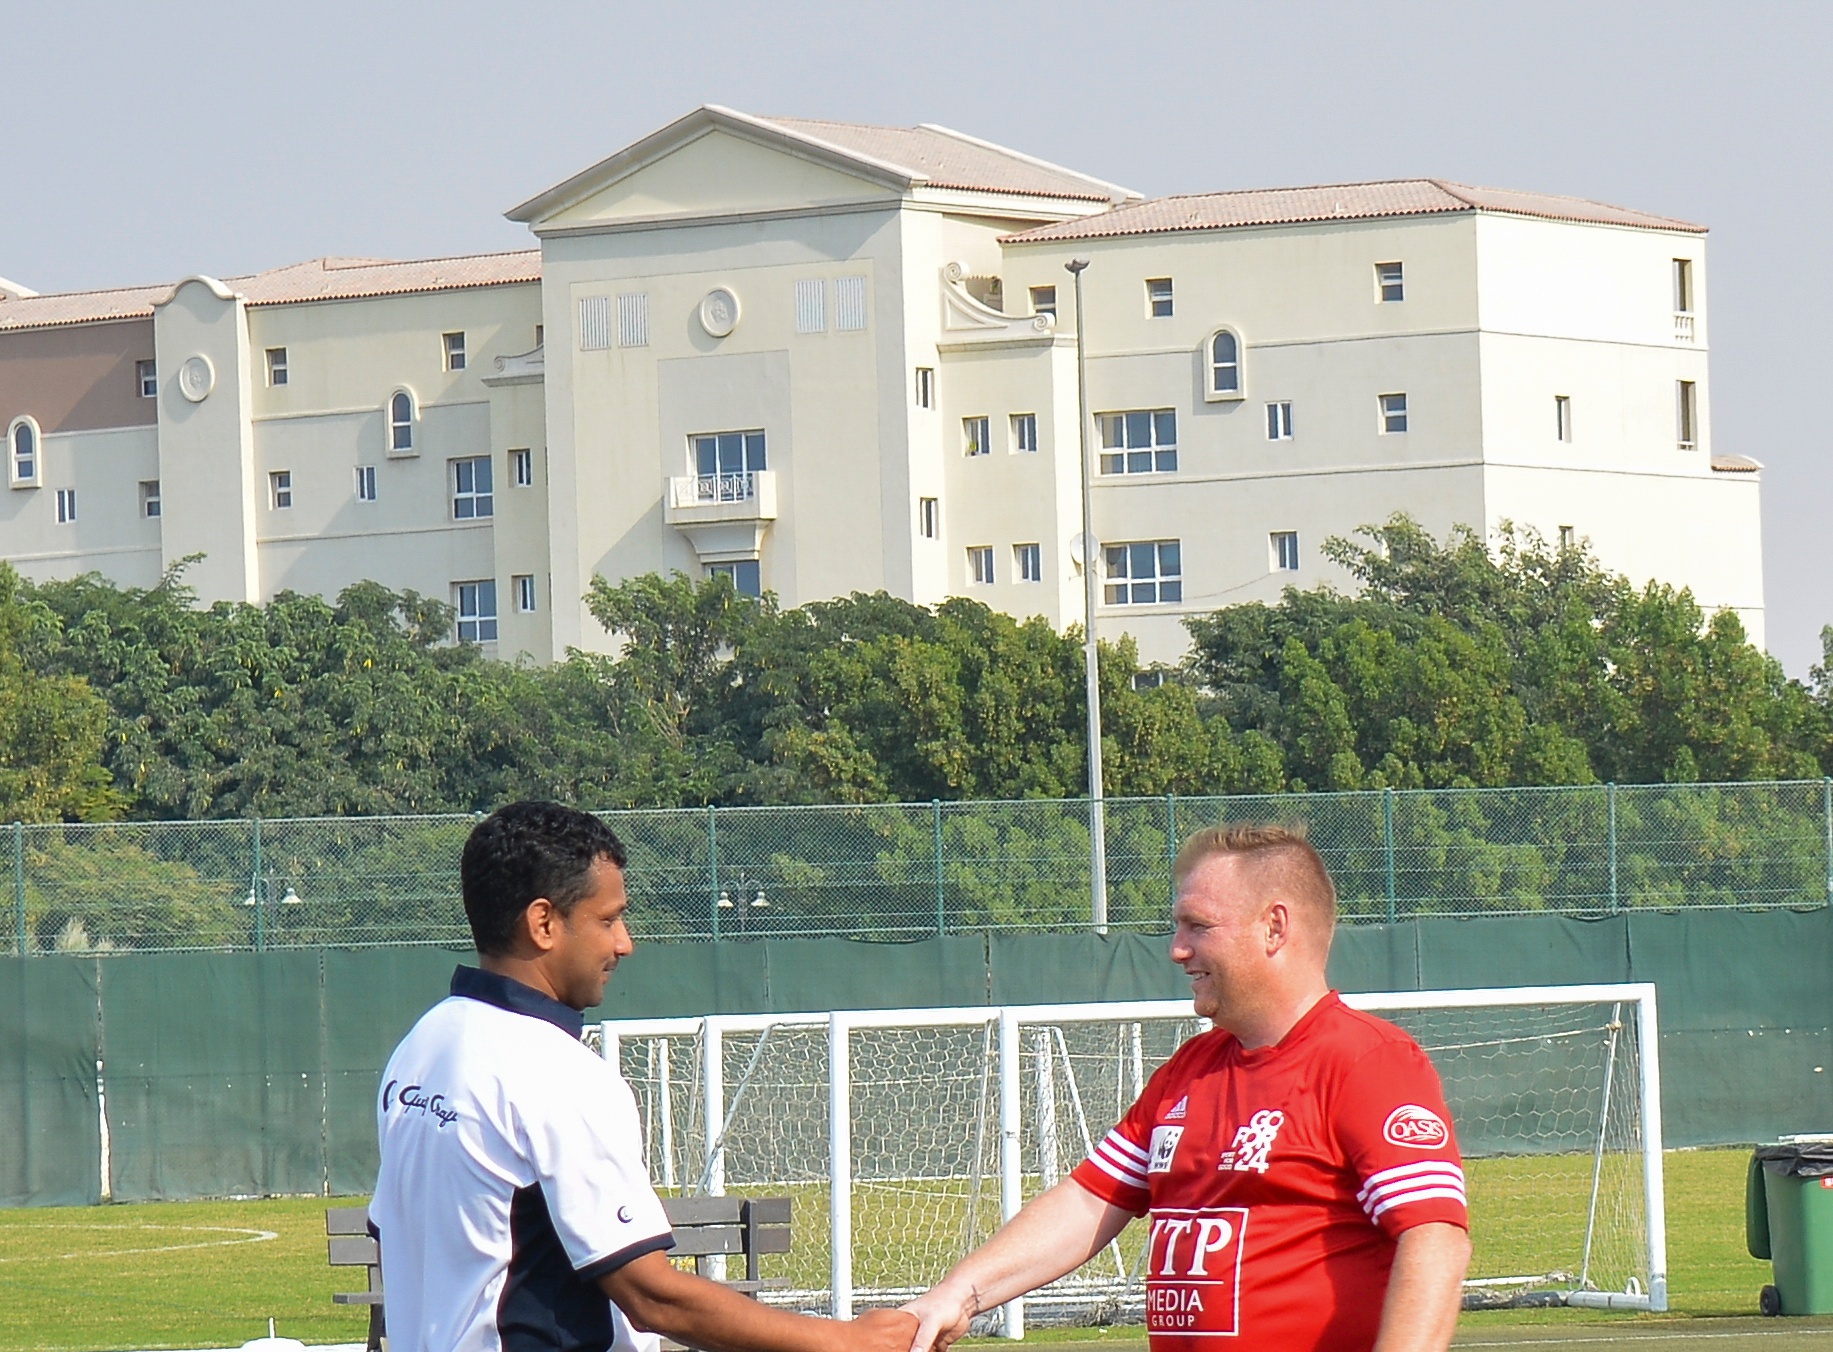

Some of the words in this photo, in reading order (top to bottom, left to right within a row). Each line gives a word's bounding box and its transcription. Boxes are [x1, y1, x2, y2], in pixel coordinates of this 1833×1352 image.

[1250, 1109, 1285, 1131] GO
[1391, 1120, 1443, 1139] OASIS
[1231, 1126, 1278, 1151] FOR
[1234, 1147, 1270, 1174] 24
[1147, 1218, 1233, 1276] ITP
[1147, 1289, 1204, 1312] MEDIA
[1151, 1314, 1195, 1327] GROUP
